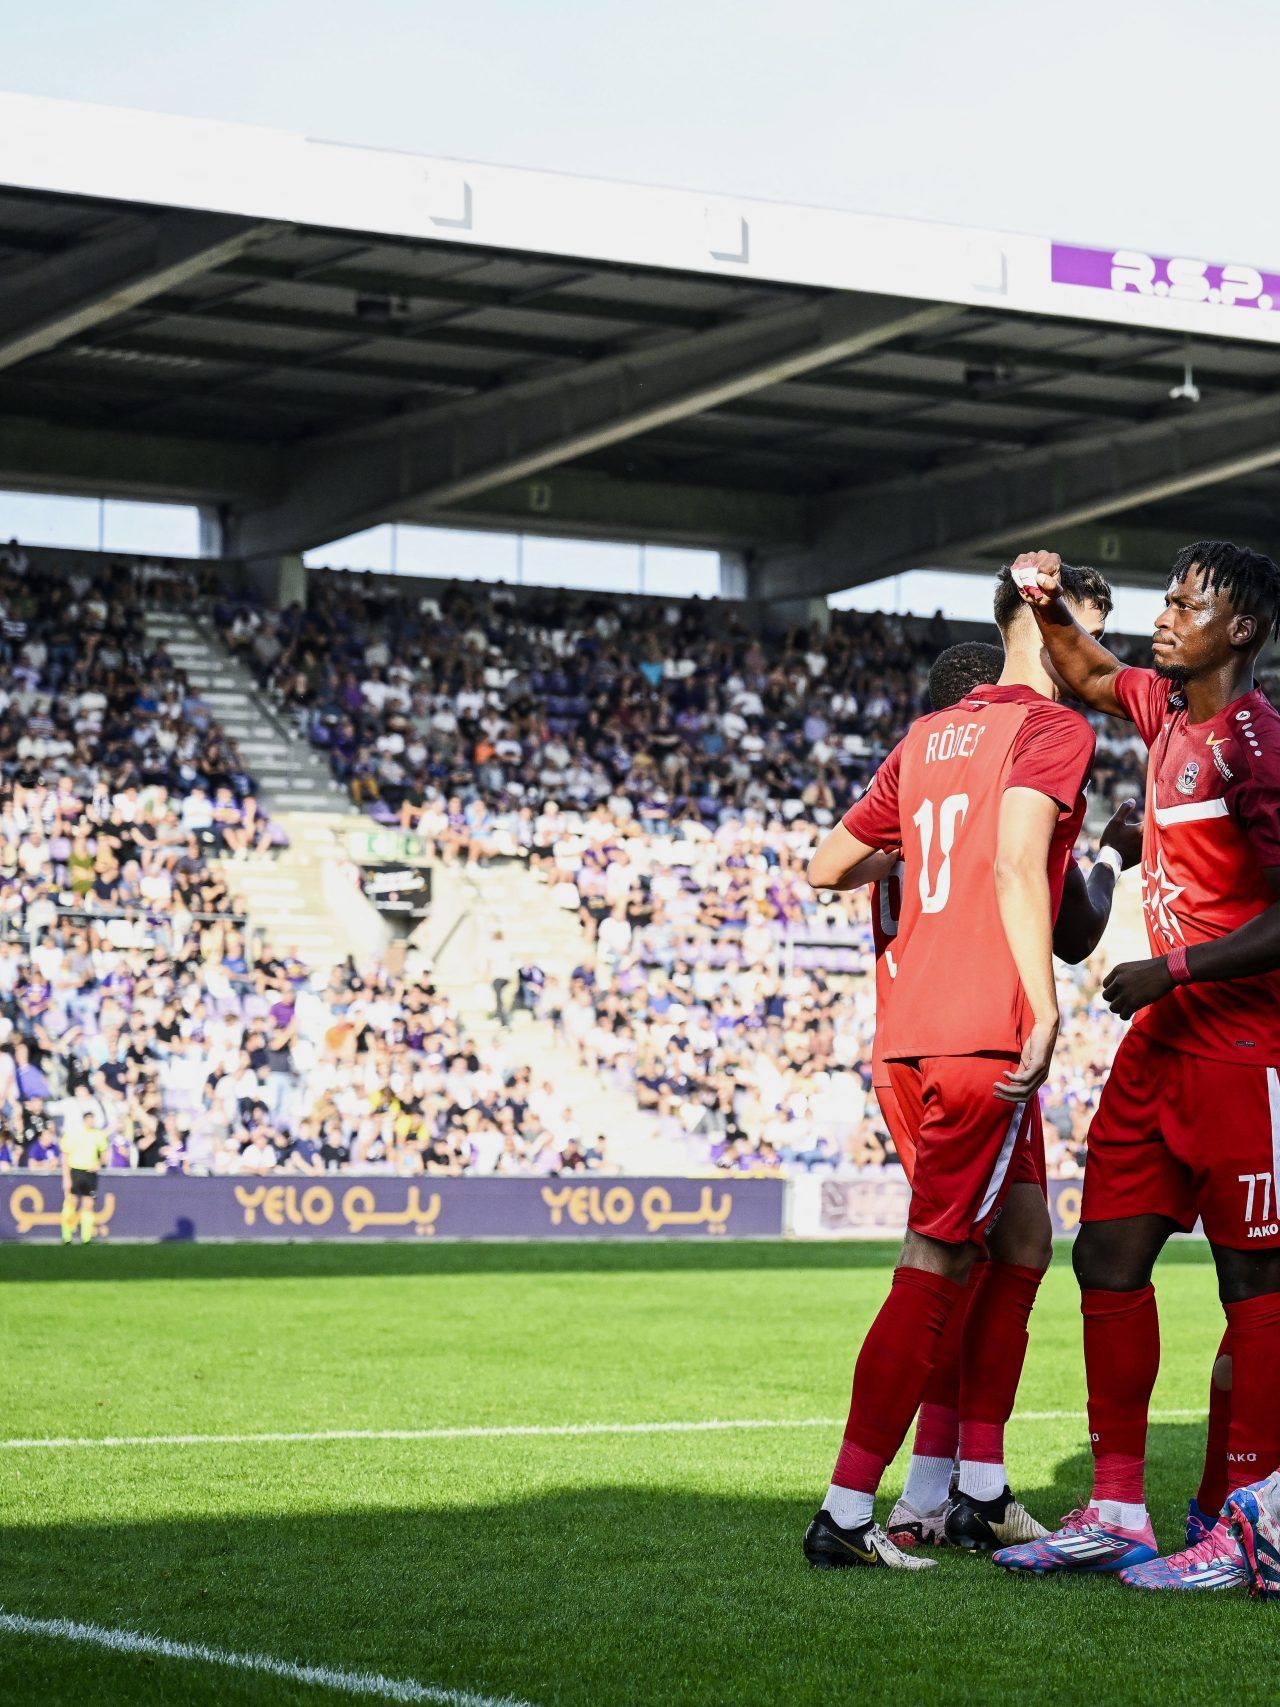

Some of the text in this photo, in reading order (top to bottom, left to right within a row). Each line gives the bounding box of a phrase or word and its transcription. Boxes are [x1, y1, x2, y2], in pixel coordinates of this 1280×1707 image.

[1110, 249, 1274, 312] R.S.P.
[234, 1185, 334, 1226] YELO
[541, 1186, 634, 1225] YELO
[1238, 1172, 1272, 1222] 77
[1247, 1223, 1279, 1238] JAKO
